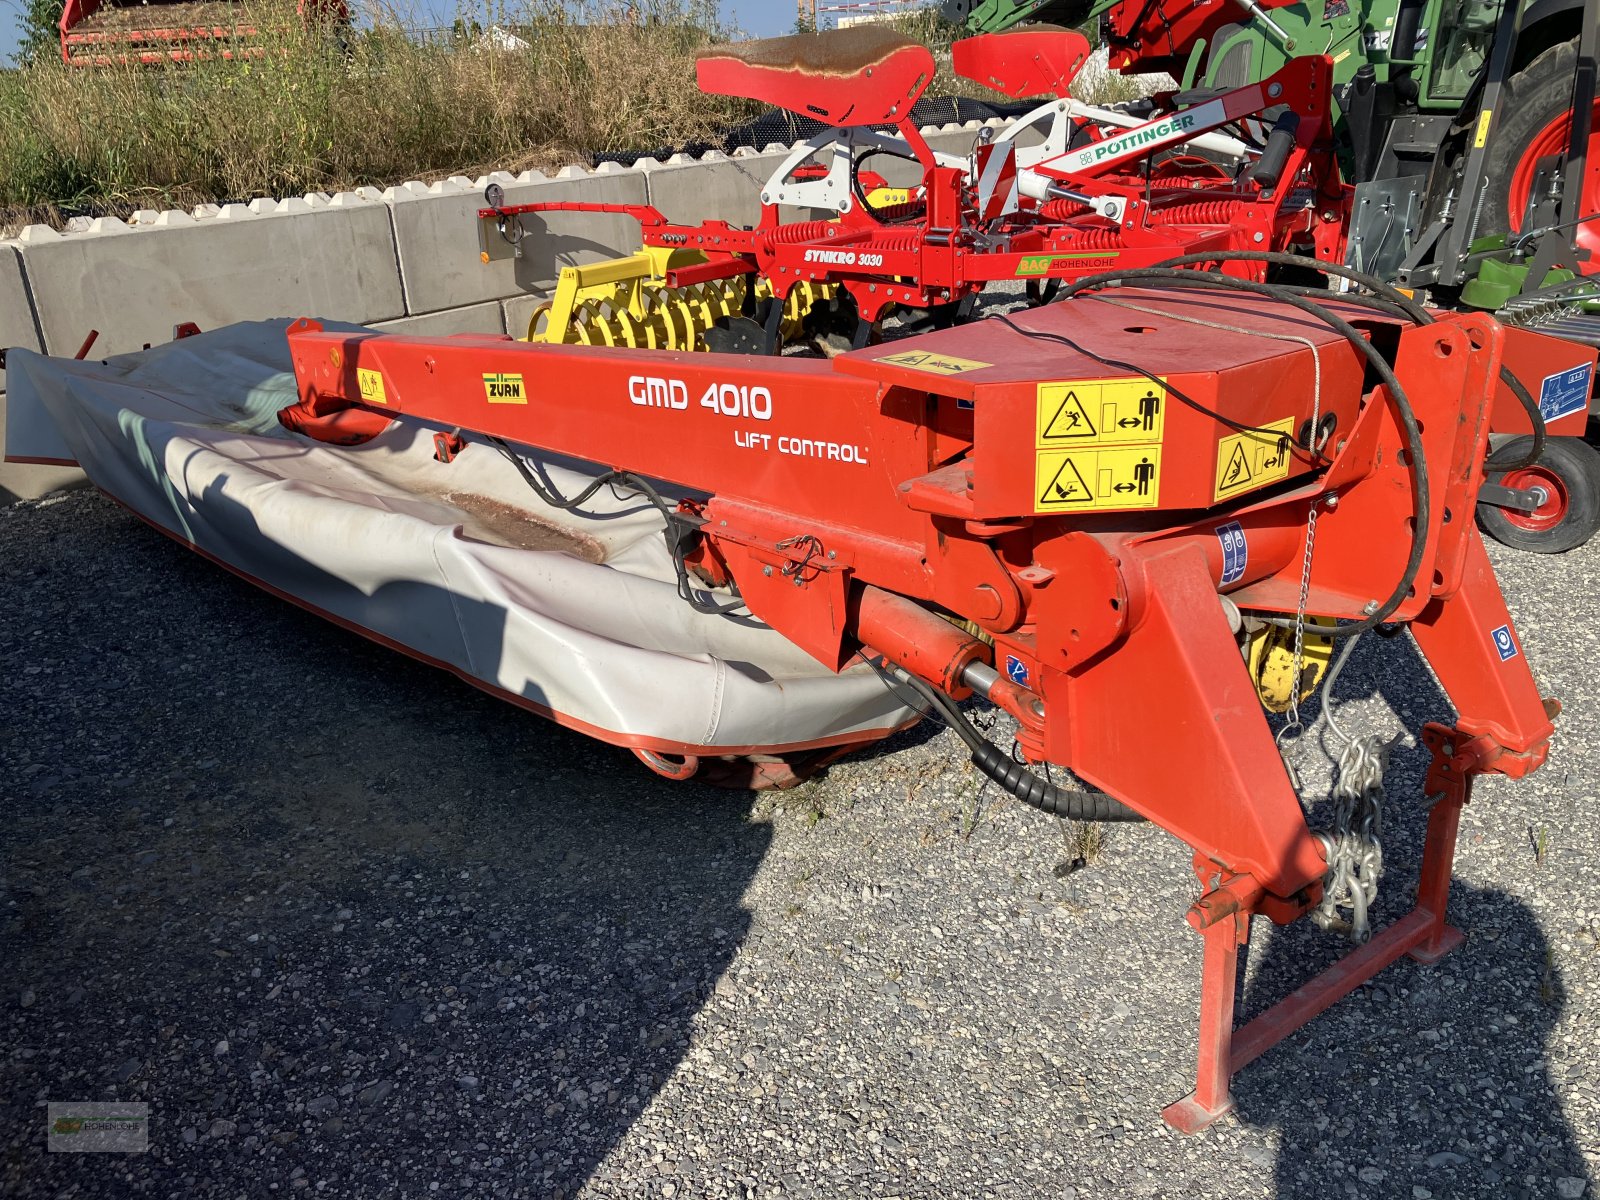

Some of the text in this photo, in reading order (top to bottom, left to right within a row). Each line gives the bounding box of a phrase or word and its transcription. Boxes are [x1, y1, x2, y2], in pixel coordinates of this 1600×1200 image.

[1095, 115, 1195, 159] PÖTTINGER
[804, 249, 883, 266] SYNKRO 3030
[1020, 258, 1114, 271] BAG HOHENLOHE
[628, 375, 772, 420] GMD 4010
[734, 430, 867, 464] LIFT CONTROL
